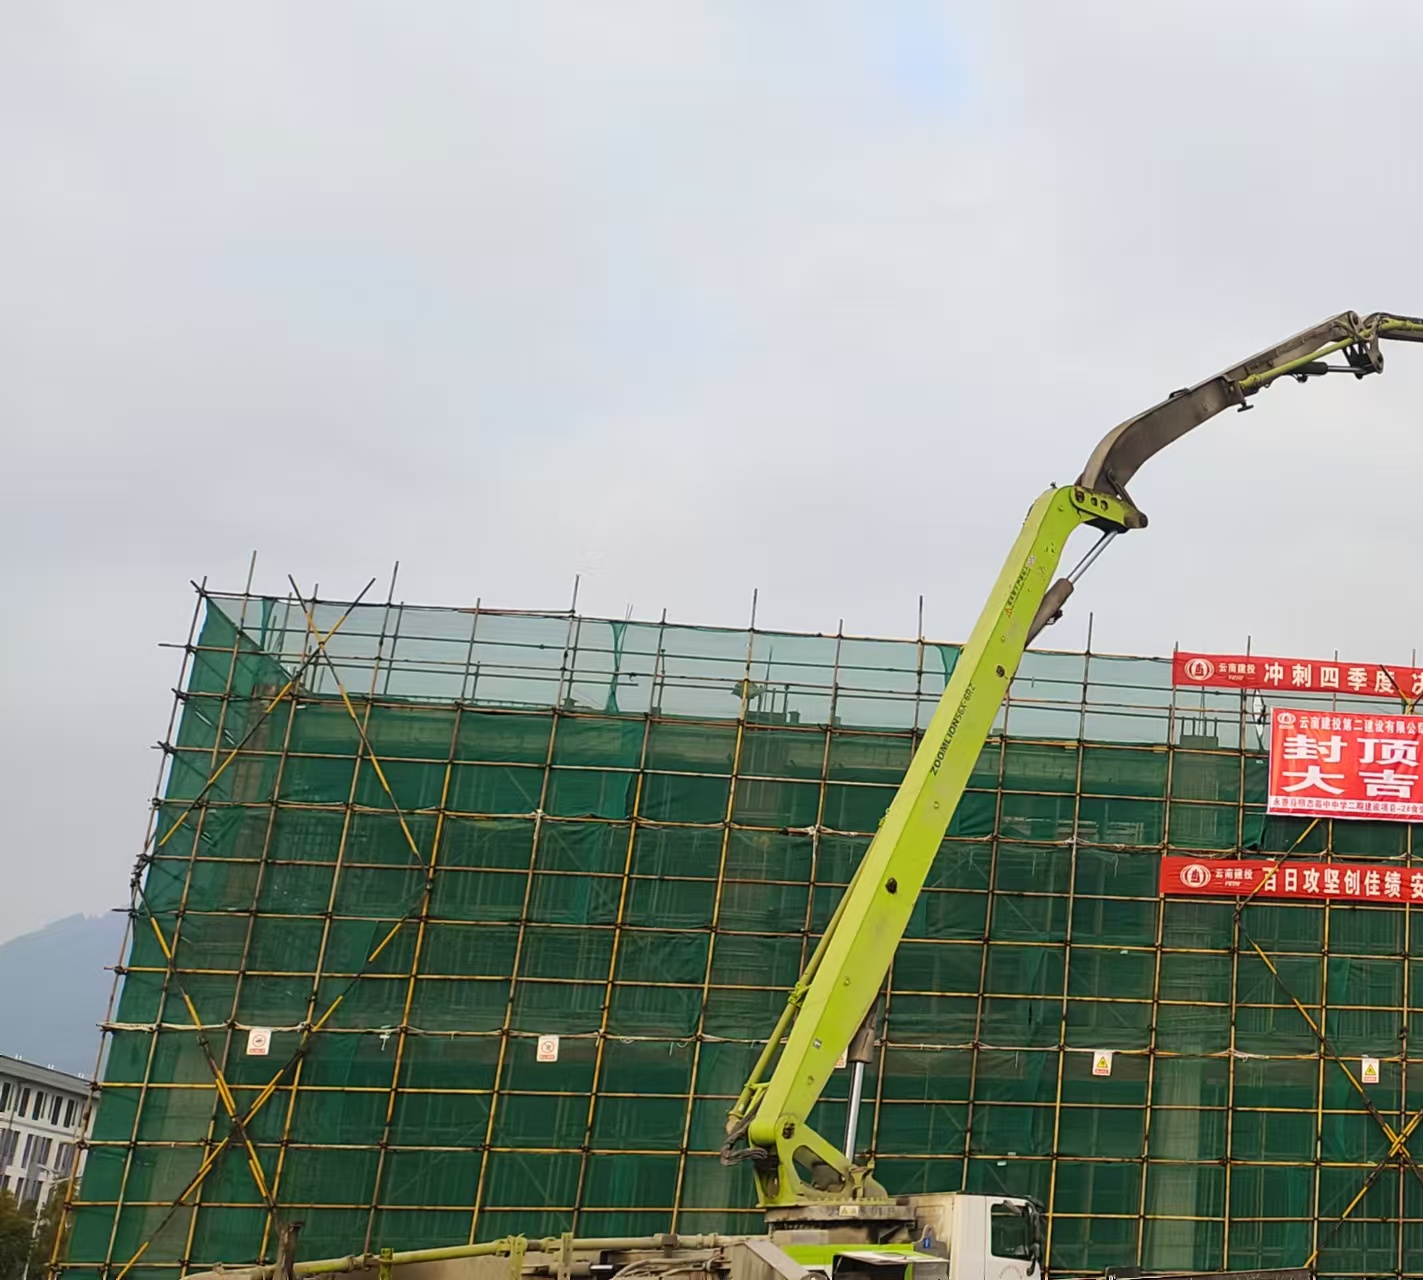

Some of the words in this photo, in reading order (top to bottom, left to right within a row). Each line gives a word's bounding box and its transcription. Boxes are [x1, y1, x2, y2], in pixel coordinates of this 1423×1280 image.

[1263, 661, 1395, 695] 冲刺四季度
[1283, 734, 1420, 767] 封顶
[1281, 765, 1420, 799] 大吉
[1263, 865, 1402, 899] 百日攻坚创佳绩
